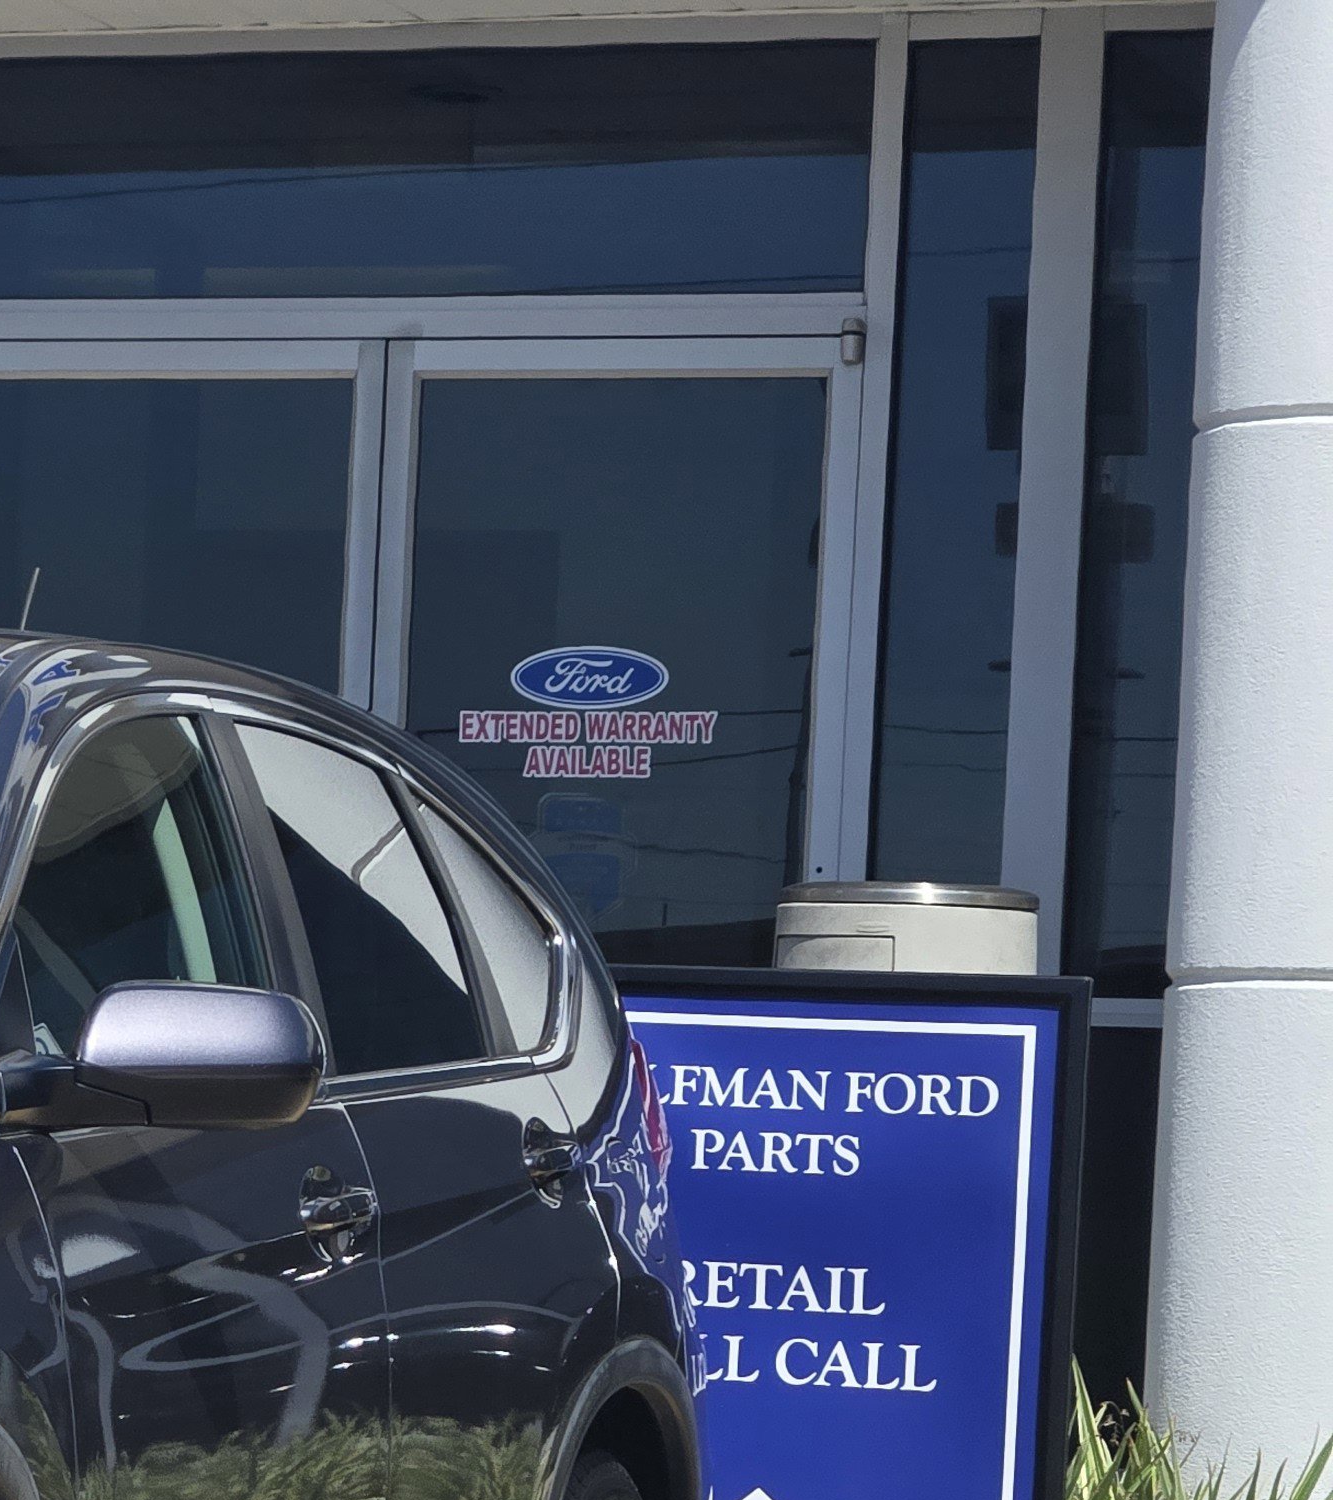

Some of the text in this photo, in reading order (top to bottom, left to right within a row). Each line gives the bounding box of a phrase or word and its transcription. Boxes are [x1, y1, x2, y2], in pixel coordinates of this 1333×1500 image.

[544, 657, 635, 694] Ford
[459, 711, 718, 744] EXTENDED WARRANTY
[523, 746, 651, 778] AVAILABLE
[845, 1071, 1001, 1118] FORD
[690, 1128, 861, 1178] PARTS
[775, 1337, 938, 1392] CALL
